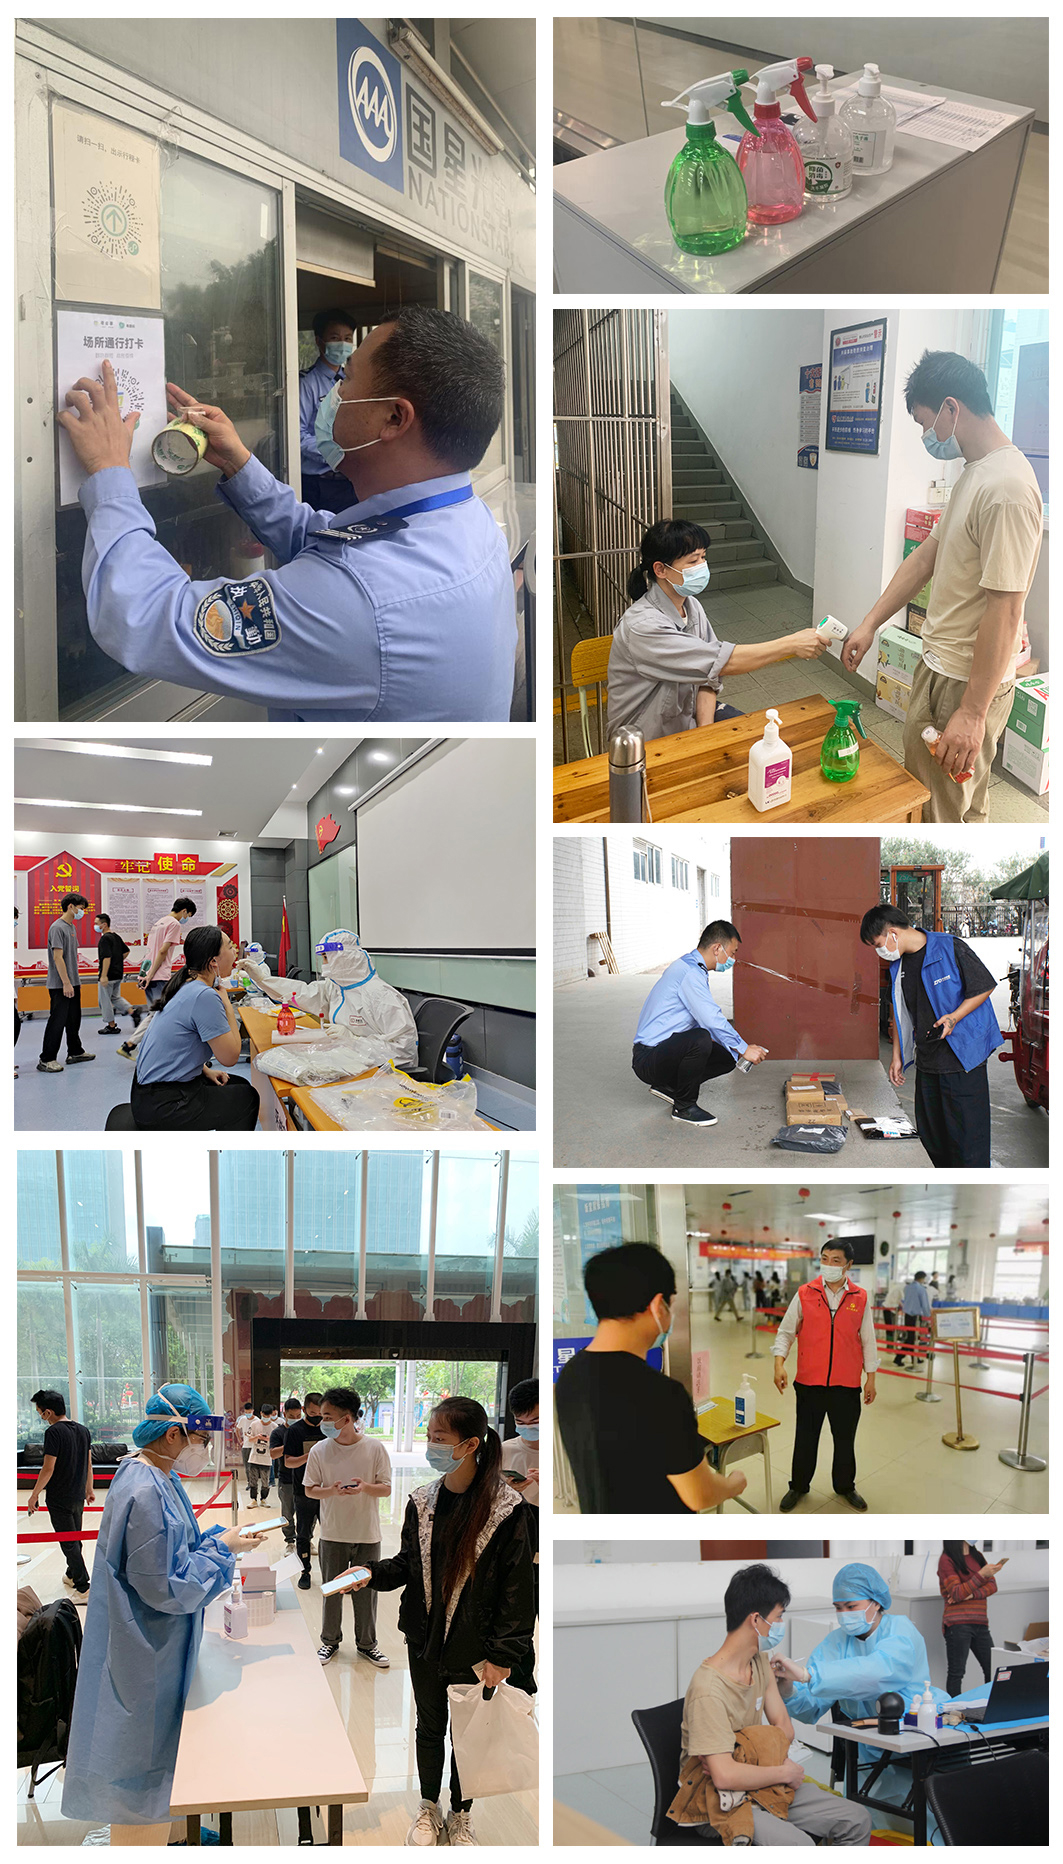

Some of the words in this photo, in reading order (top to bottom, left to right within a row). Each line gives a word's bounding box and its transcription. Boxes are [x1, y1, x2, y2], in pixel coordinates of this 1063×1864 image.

[408, 165, 511, 259] NATIONSTAR
[83, 335, 144, 350] 场所通行打卡
[230, 585, 247, 601] 执
[50, 885, 80, 893] 入党誓词
[557, 1347, 576, 1364] 星
